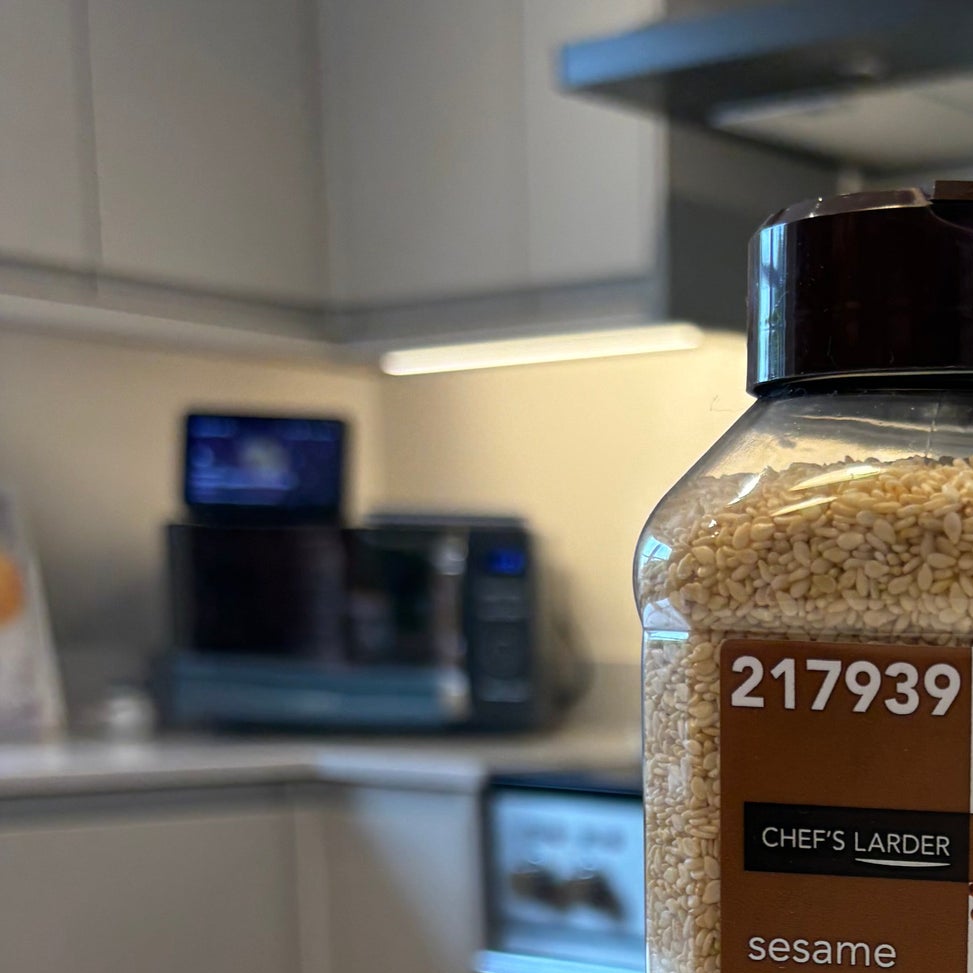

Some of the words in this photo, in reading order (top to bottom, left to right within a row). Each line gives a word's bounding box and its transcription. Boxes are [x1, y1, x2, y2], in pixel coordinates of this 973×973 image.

[730, 655, 962, 716] 217939
[761, 826, 846, 851] CHEF'S
[854, 831, 951, 857] LARDER
[747, 935, 897, 968] sesame
